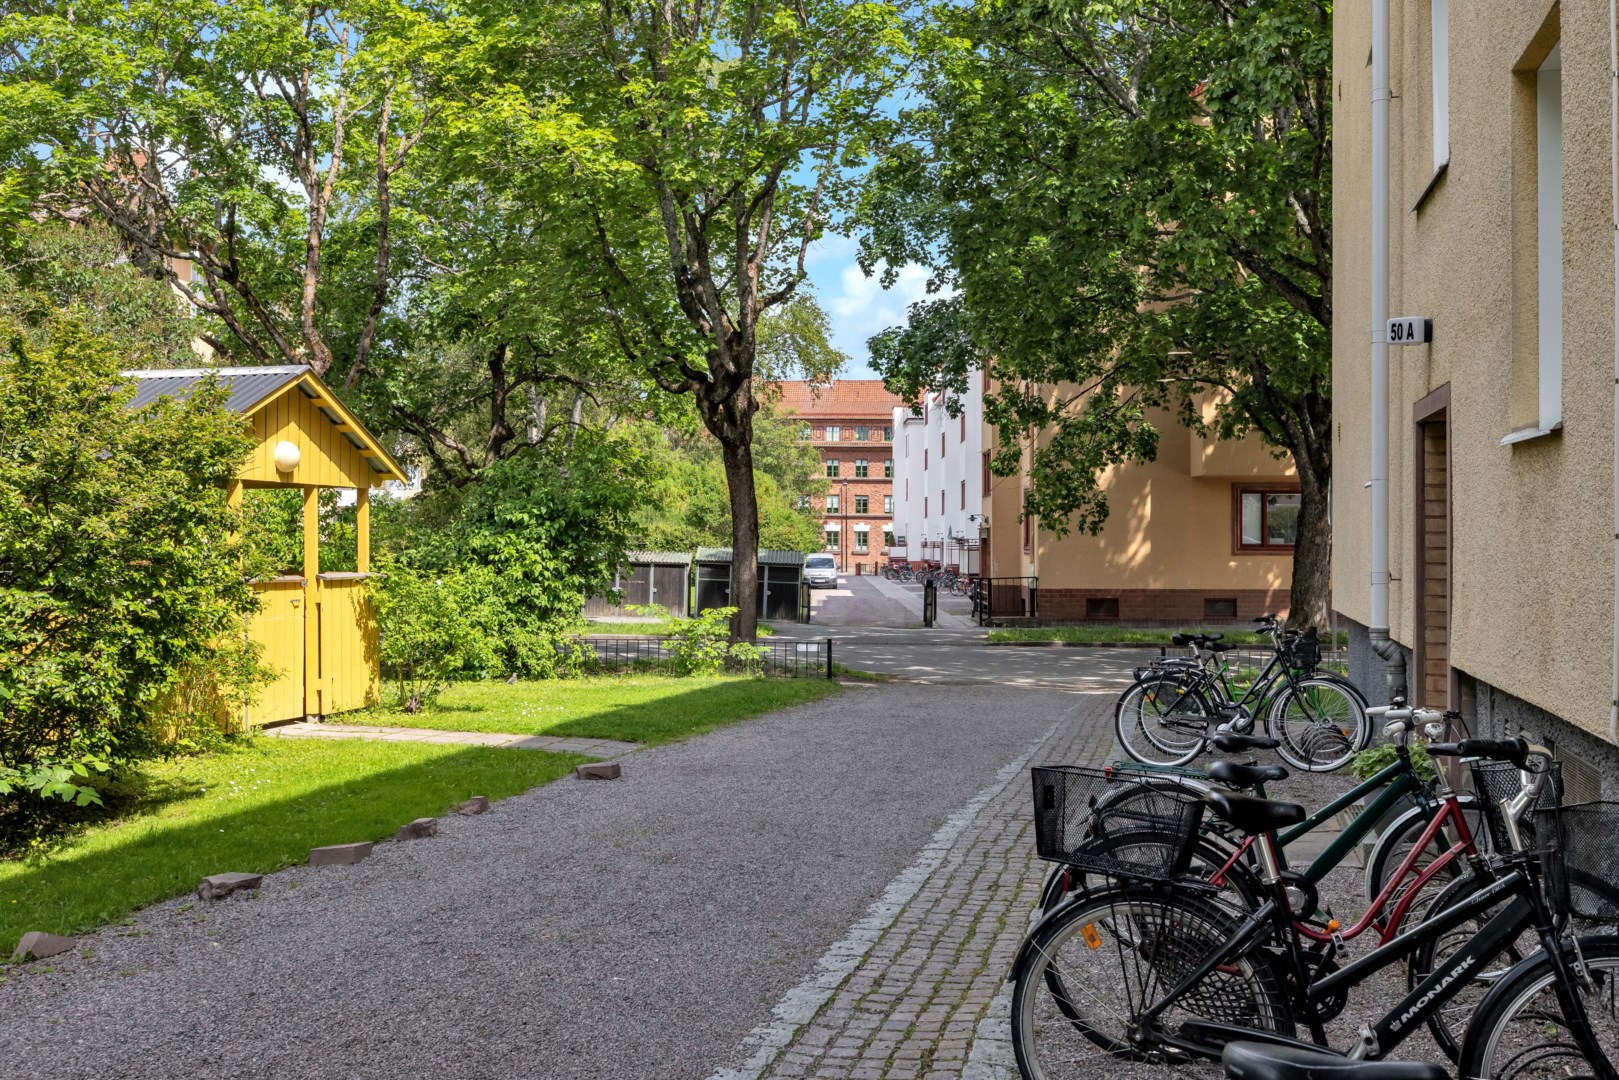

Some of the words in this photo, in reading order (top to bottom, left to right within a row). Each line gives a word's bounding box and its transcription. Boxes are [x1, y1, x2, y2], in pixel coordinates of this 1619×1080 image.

[1391, 323, 1403, 341] 50
[1406, 322, 1414, 340] A
[1401, 955, 1475, 1023] MONARK
